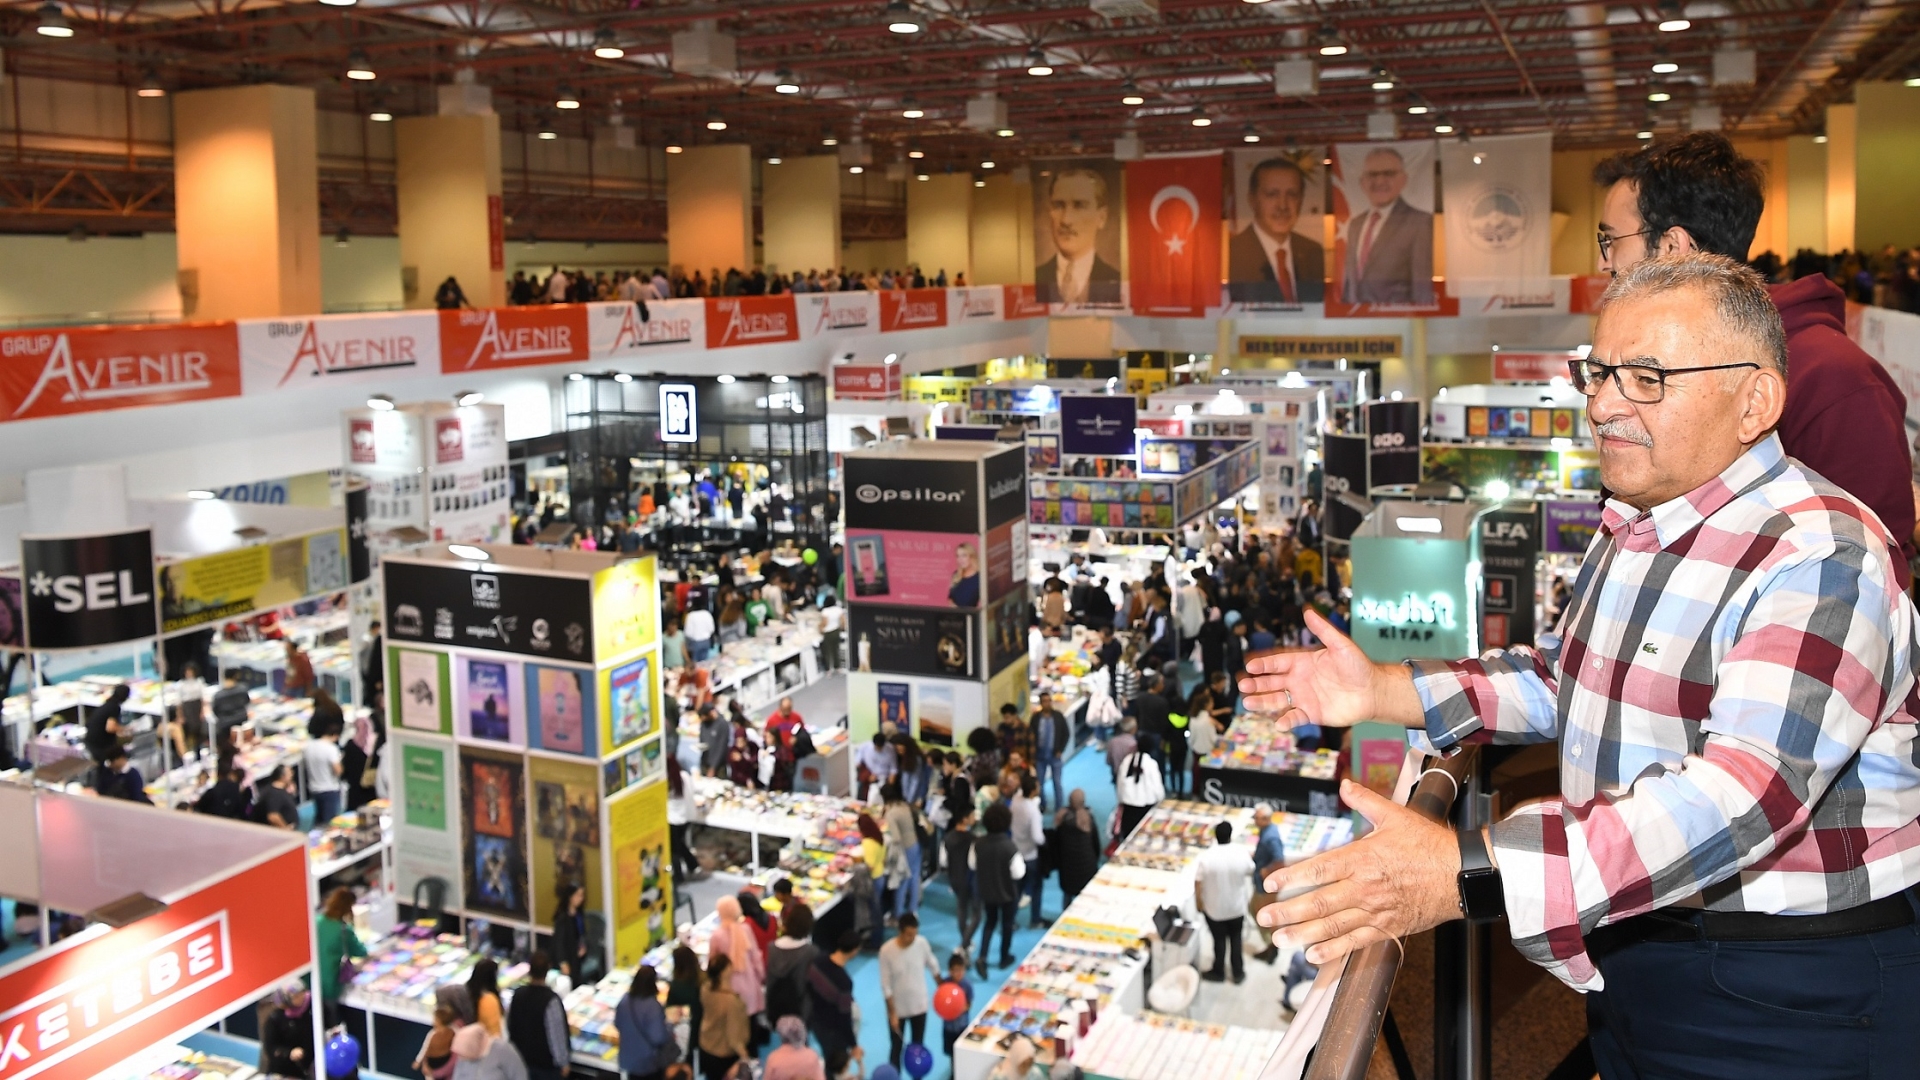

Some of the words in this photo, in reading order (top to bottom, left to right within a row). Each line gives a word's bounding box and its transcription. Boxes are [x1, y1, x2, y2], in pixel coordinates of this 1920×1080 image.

[460, 310, 486, 325] GRUP
[720, 299, 787, 346] AVENIR
[268, 322, 302, 337] GRUP
[465, 311, 571, 369] AVENIR
[610, 305, 691, 356] AVENIR
[2, 335, 51, 357] GRUP
[277, 320, 415, 388] AVENIR
[12, 333, 209, 418] AVENIR
[856, 484, 961, 503] epsilon
[1483, 521, 1529, 539] LFA
[1378, 626, 1434, 641] KİTAP
